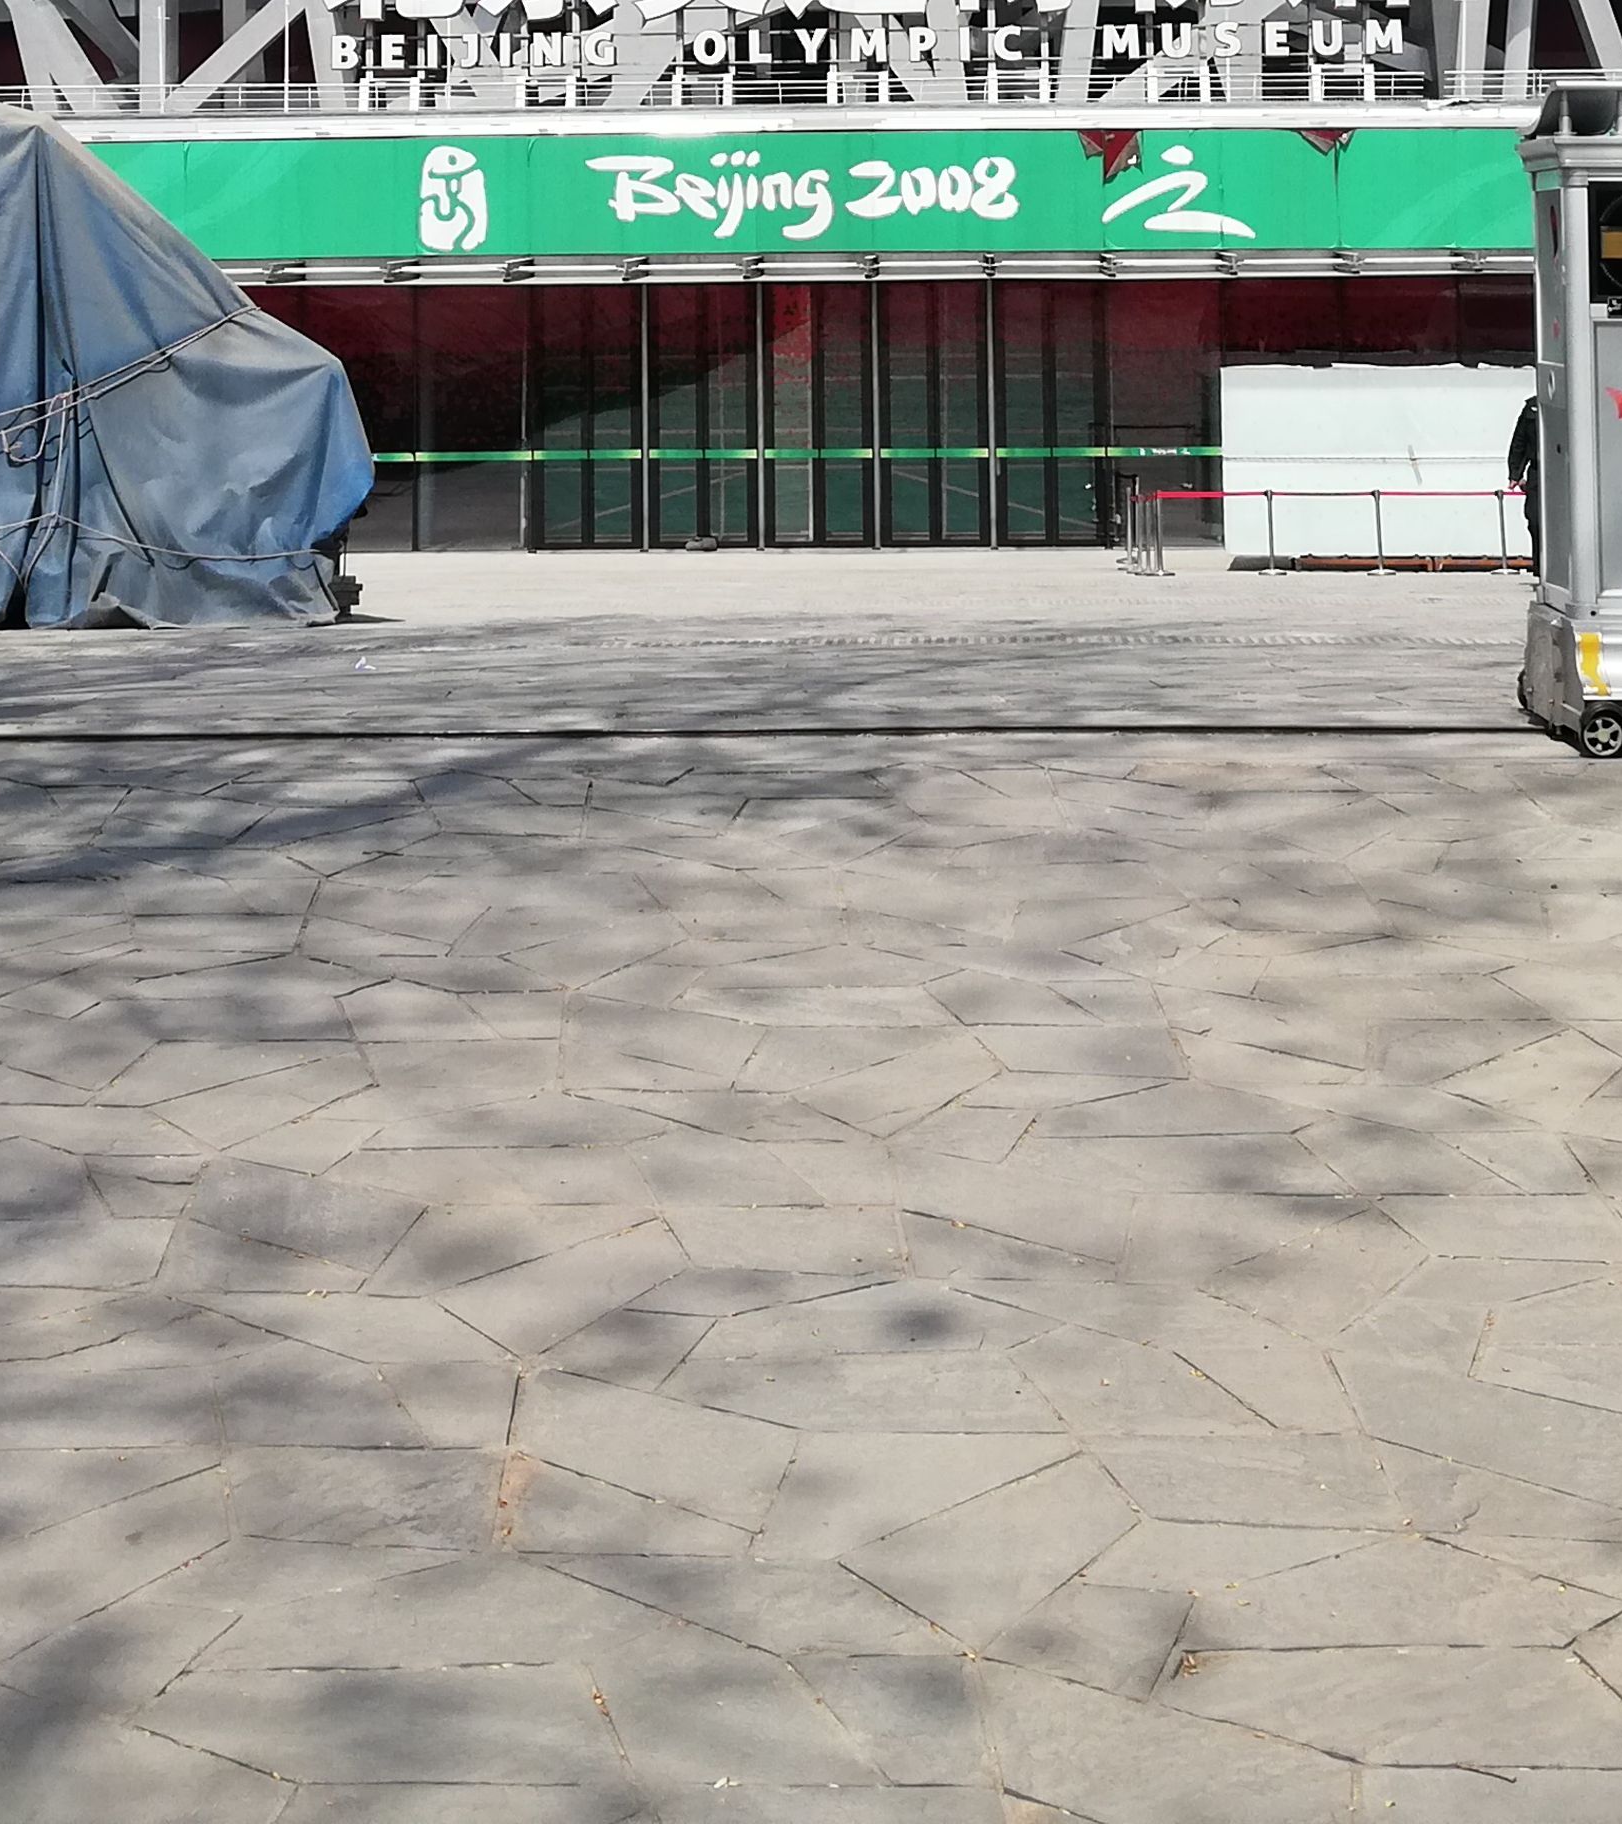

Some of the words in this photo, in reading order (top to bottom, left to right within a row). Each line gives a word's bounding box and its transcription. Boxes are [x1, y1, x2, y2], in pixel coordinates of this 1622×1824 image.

[330, 30, 617, 69] BEIJING
[692, 25, 1024, 66] OLYMPIC
[1101, 18, 1405, 60] MUSEUM
[585, 150, 833, 240] Beijing
[845, 156, 1020, 220] 2008
